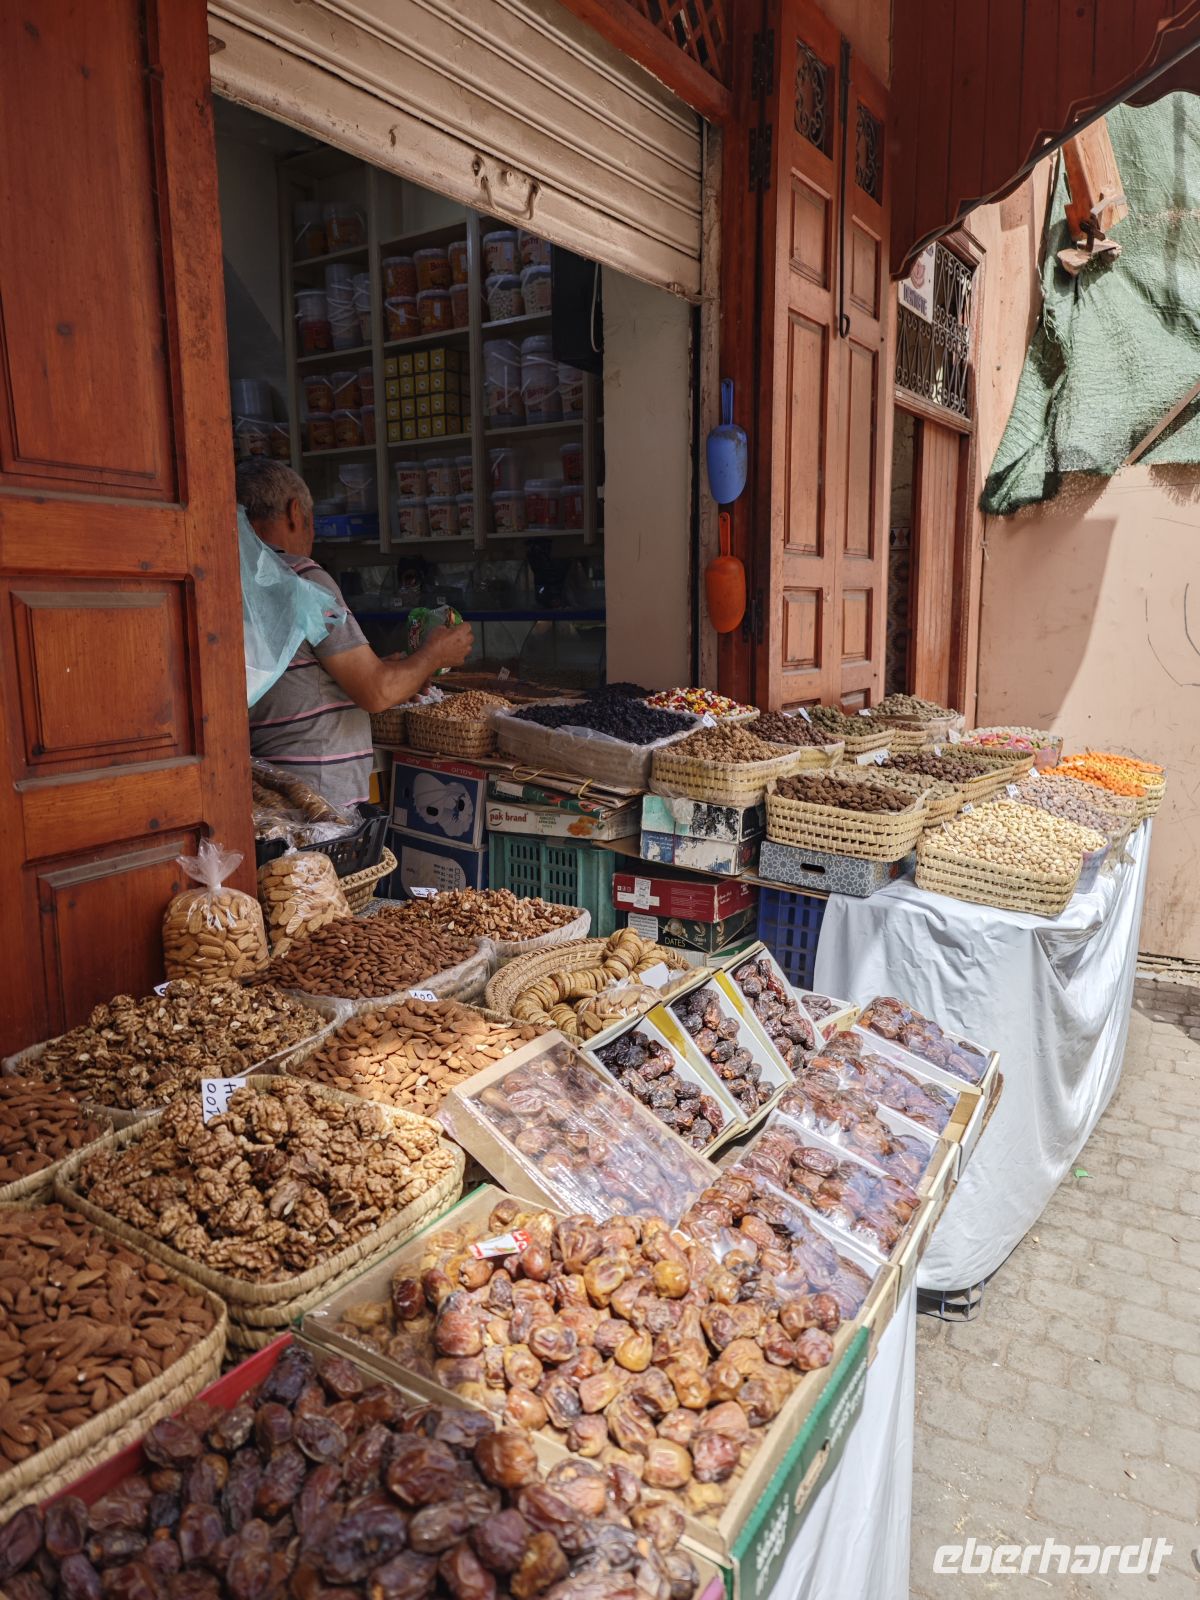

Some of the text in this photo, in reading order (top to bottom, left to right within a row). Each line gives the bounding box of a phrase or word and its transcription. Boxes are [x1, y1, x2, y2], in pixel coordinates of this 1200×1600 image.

[489, 811, 527, 823] pak brand
[664, 937, 686, 948] DATES
